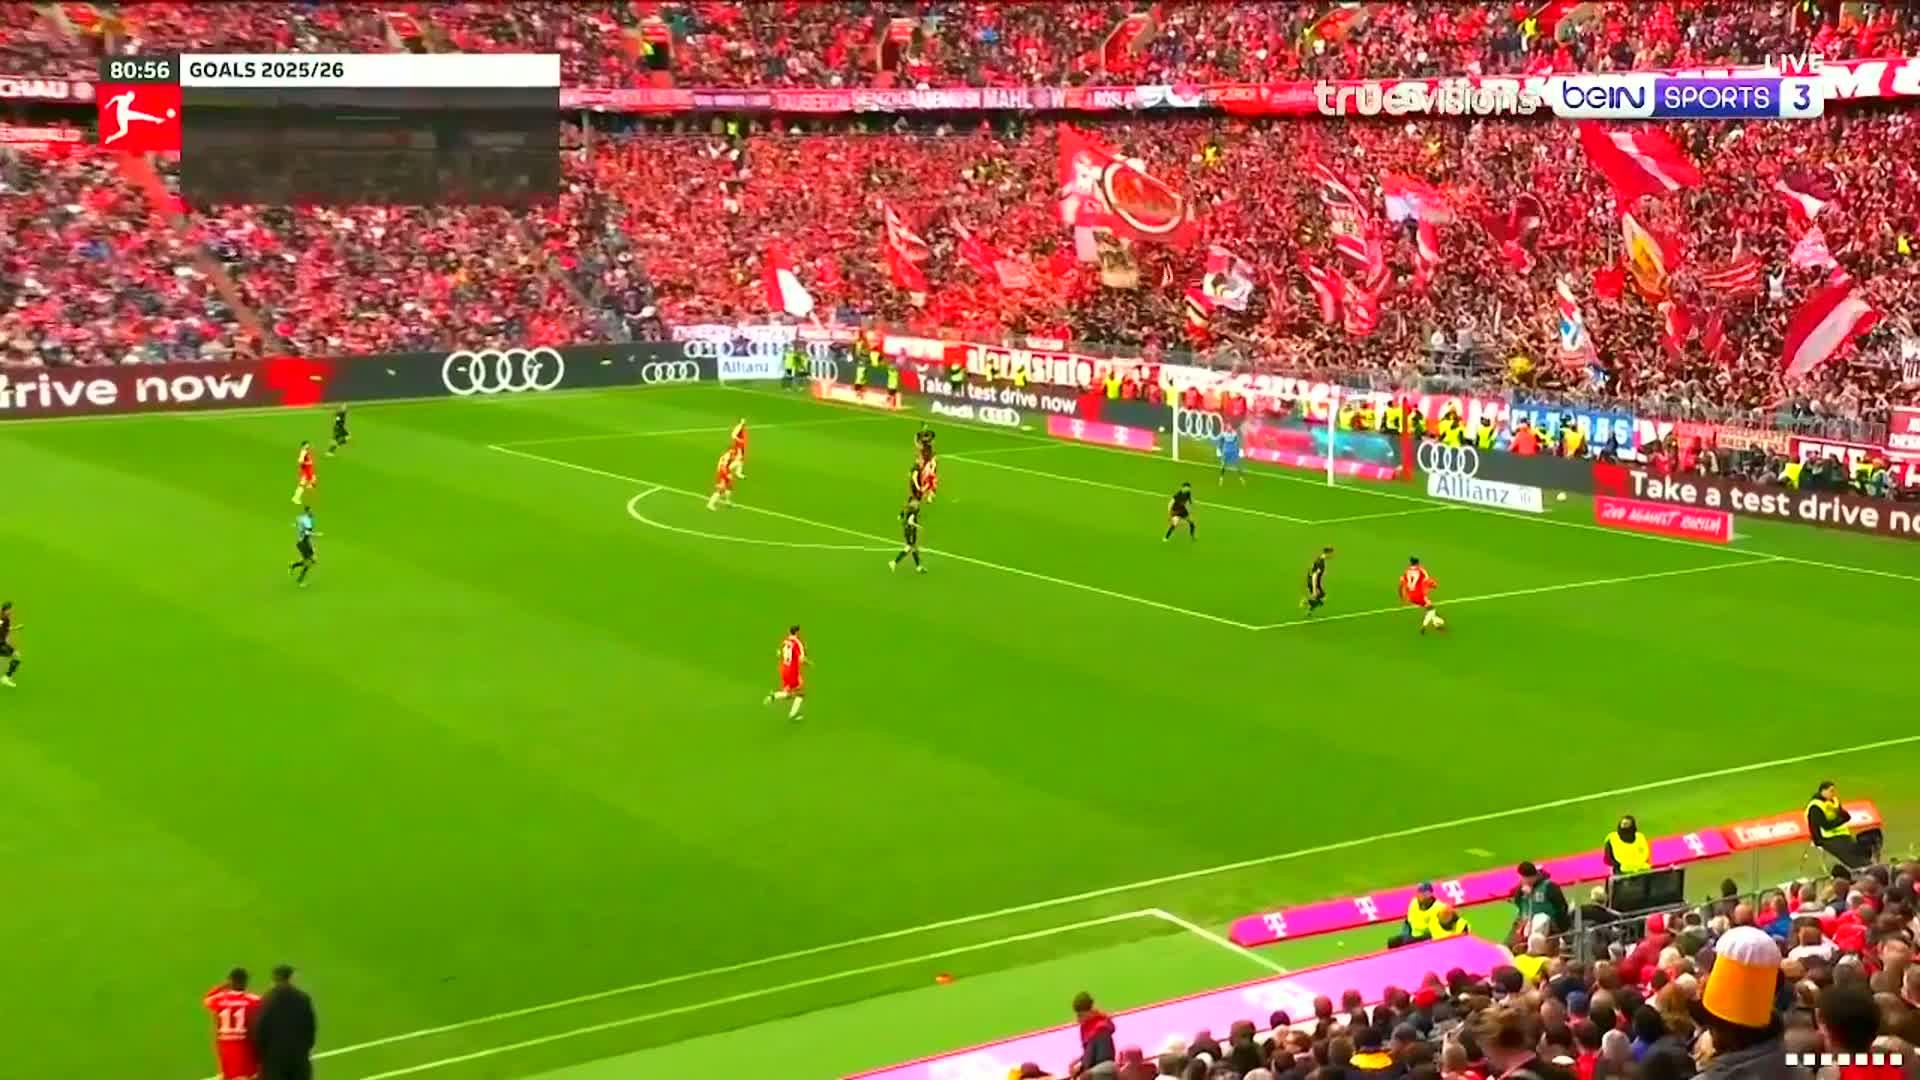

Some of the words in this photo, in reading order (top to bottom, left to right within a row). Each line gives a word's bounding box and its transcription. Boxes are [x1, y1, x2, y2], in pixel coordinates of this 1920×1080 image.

[136, 374, 253, 403] now
[919, 373, 950, 395] Take
[967, 382, 997, 402] test
[1000, 387, 1038, 409] drive
[1041, 397, 1077, 415] now
[1436, 474, 1511, 505] Allianz
[1630, 470, 1697, 502] Take
[1705, 485, 1721, 506] a
[1731, 487, 1791, 518] test
[1799, 494, 1878, 528] drive
[218, 1007, 247, 1034] 11
